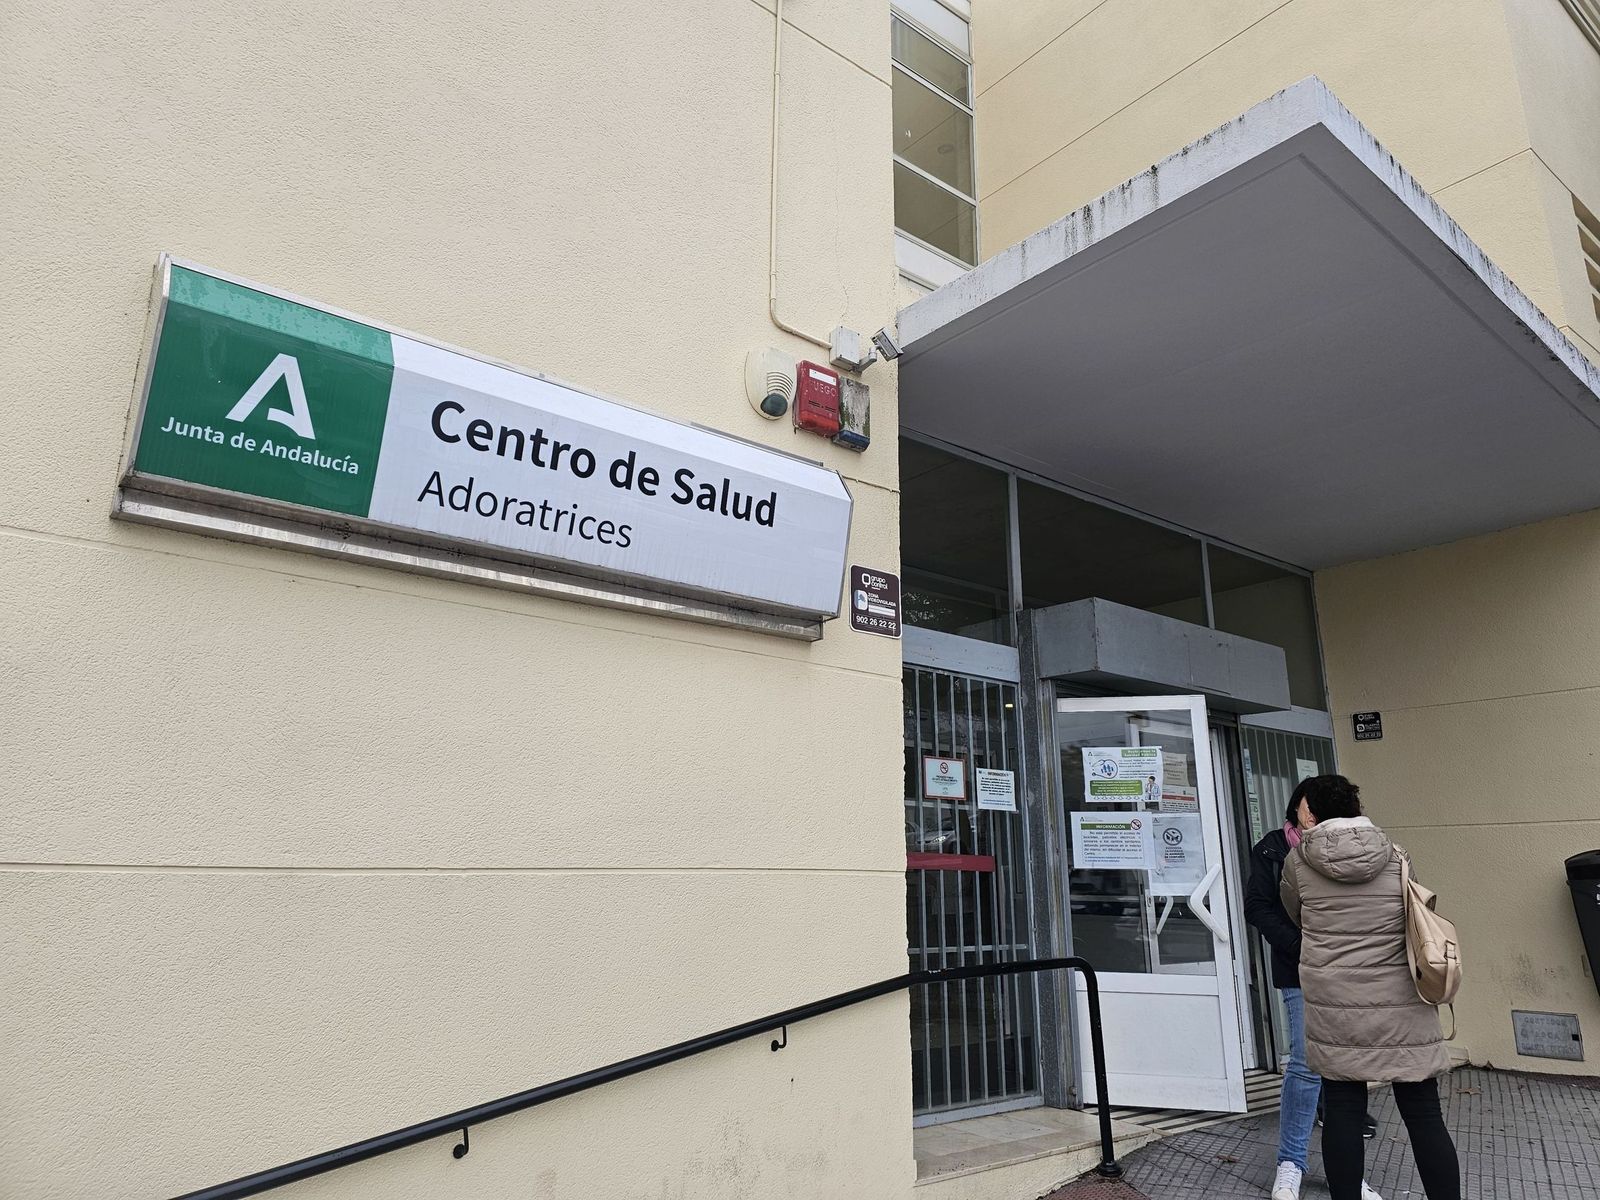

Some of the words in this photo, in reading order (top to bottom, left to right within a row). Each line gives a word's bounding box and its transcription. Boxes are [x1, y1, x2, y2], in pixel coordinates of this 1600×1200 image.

[161, 416, 225, 445] Junta
[230, 432, 256, 452] de
[260, 439, 360, 475] Andalucía
[430, 400, 597, 479] Centro
[608, 450, 660, 497] de
[670, 467, 777, 528] Salud
[417, 470, 632, 548] Adoratrices
[870, 575, 886, 583] grupo
[856, 615, 868, 624] 902
[869, 618, 878, 626] 26
[878, 620, 887, 628] 22
[887, 621, 896, 630] 22
